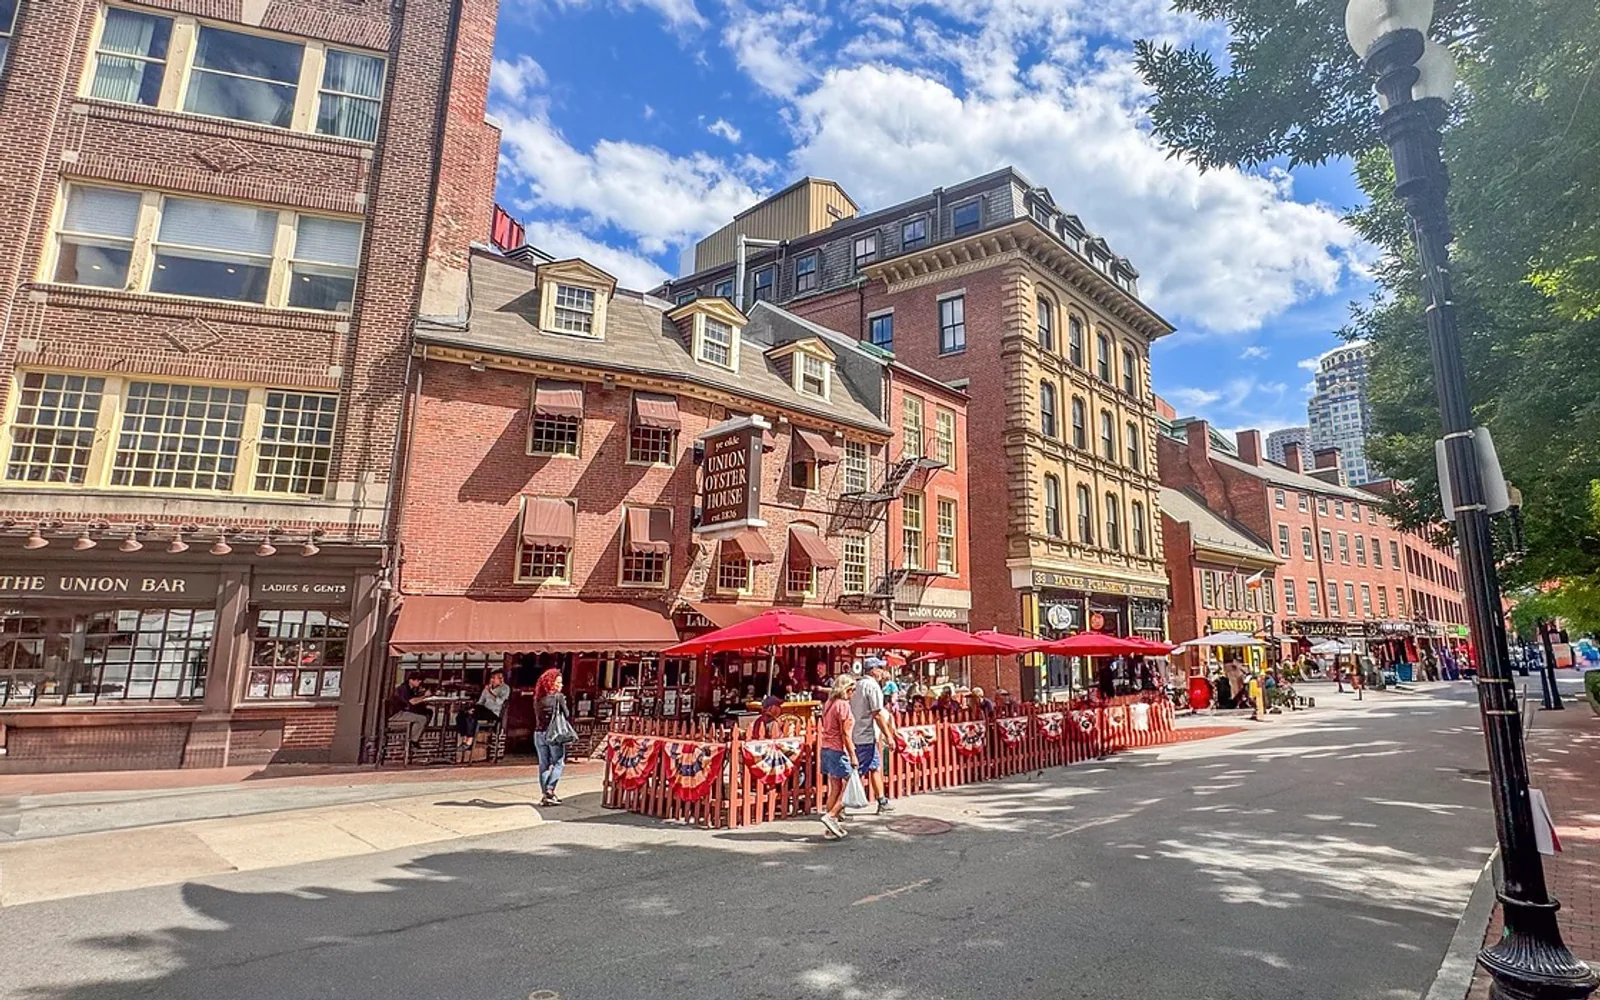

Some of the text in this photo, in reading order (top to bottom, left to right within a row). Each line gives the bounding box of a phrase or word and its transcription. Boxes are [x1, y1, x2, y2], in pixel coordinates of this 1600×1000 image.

[708, 449, 746, 472] UNION
[705, 469, 747, 491] OYSTER
[707, 487, 743, 509] HOUSE
[0, 576, 186, 593] THE UNION BAR
[261, 584, 346, 593] LADIES & GENTS
[933, 608, 957, 619] GOODS
[1211, 618, 1257, 632] HENNESSY'S
